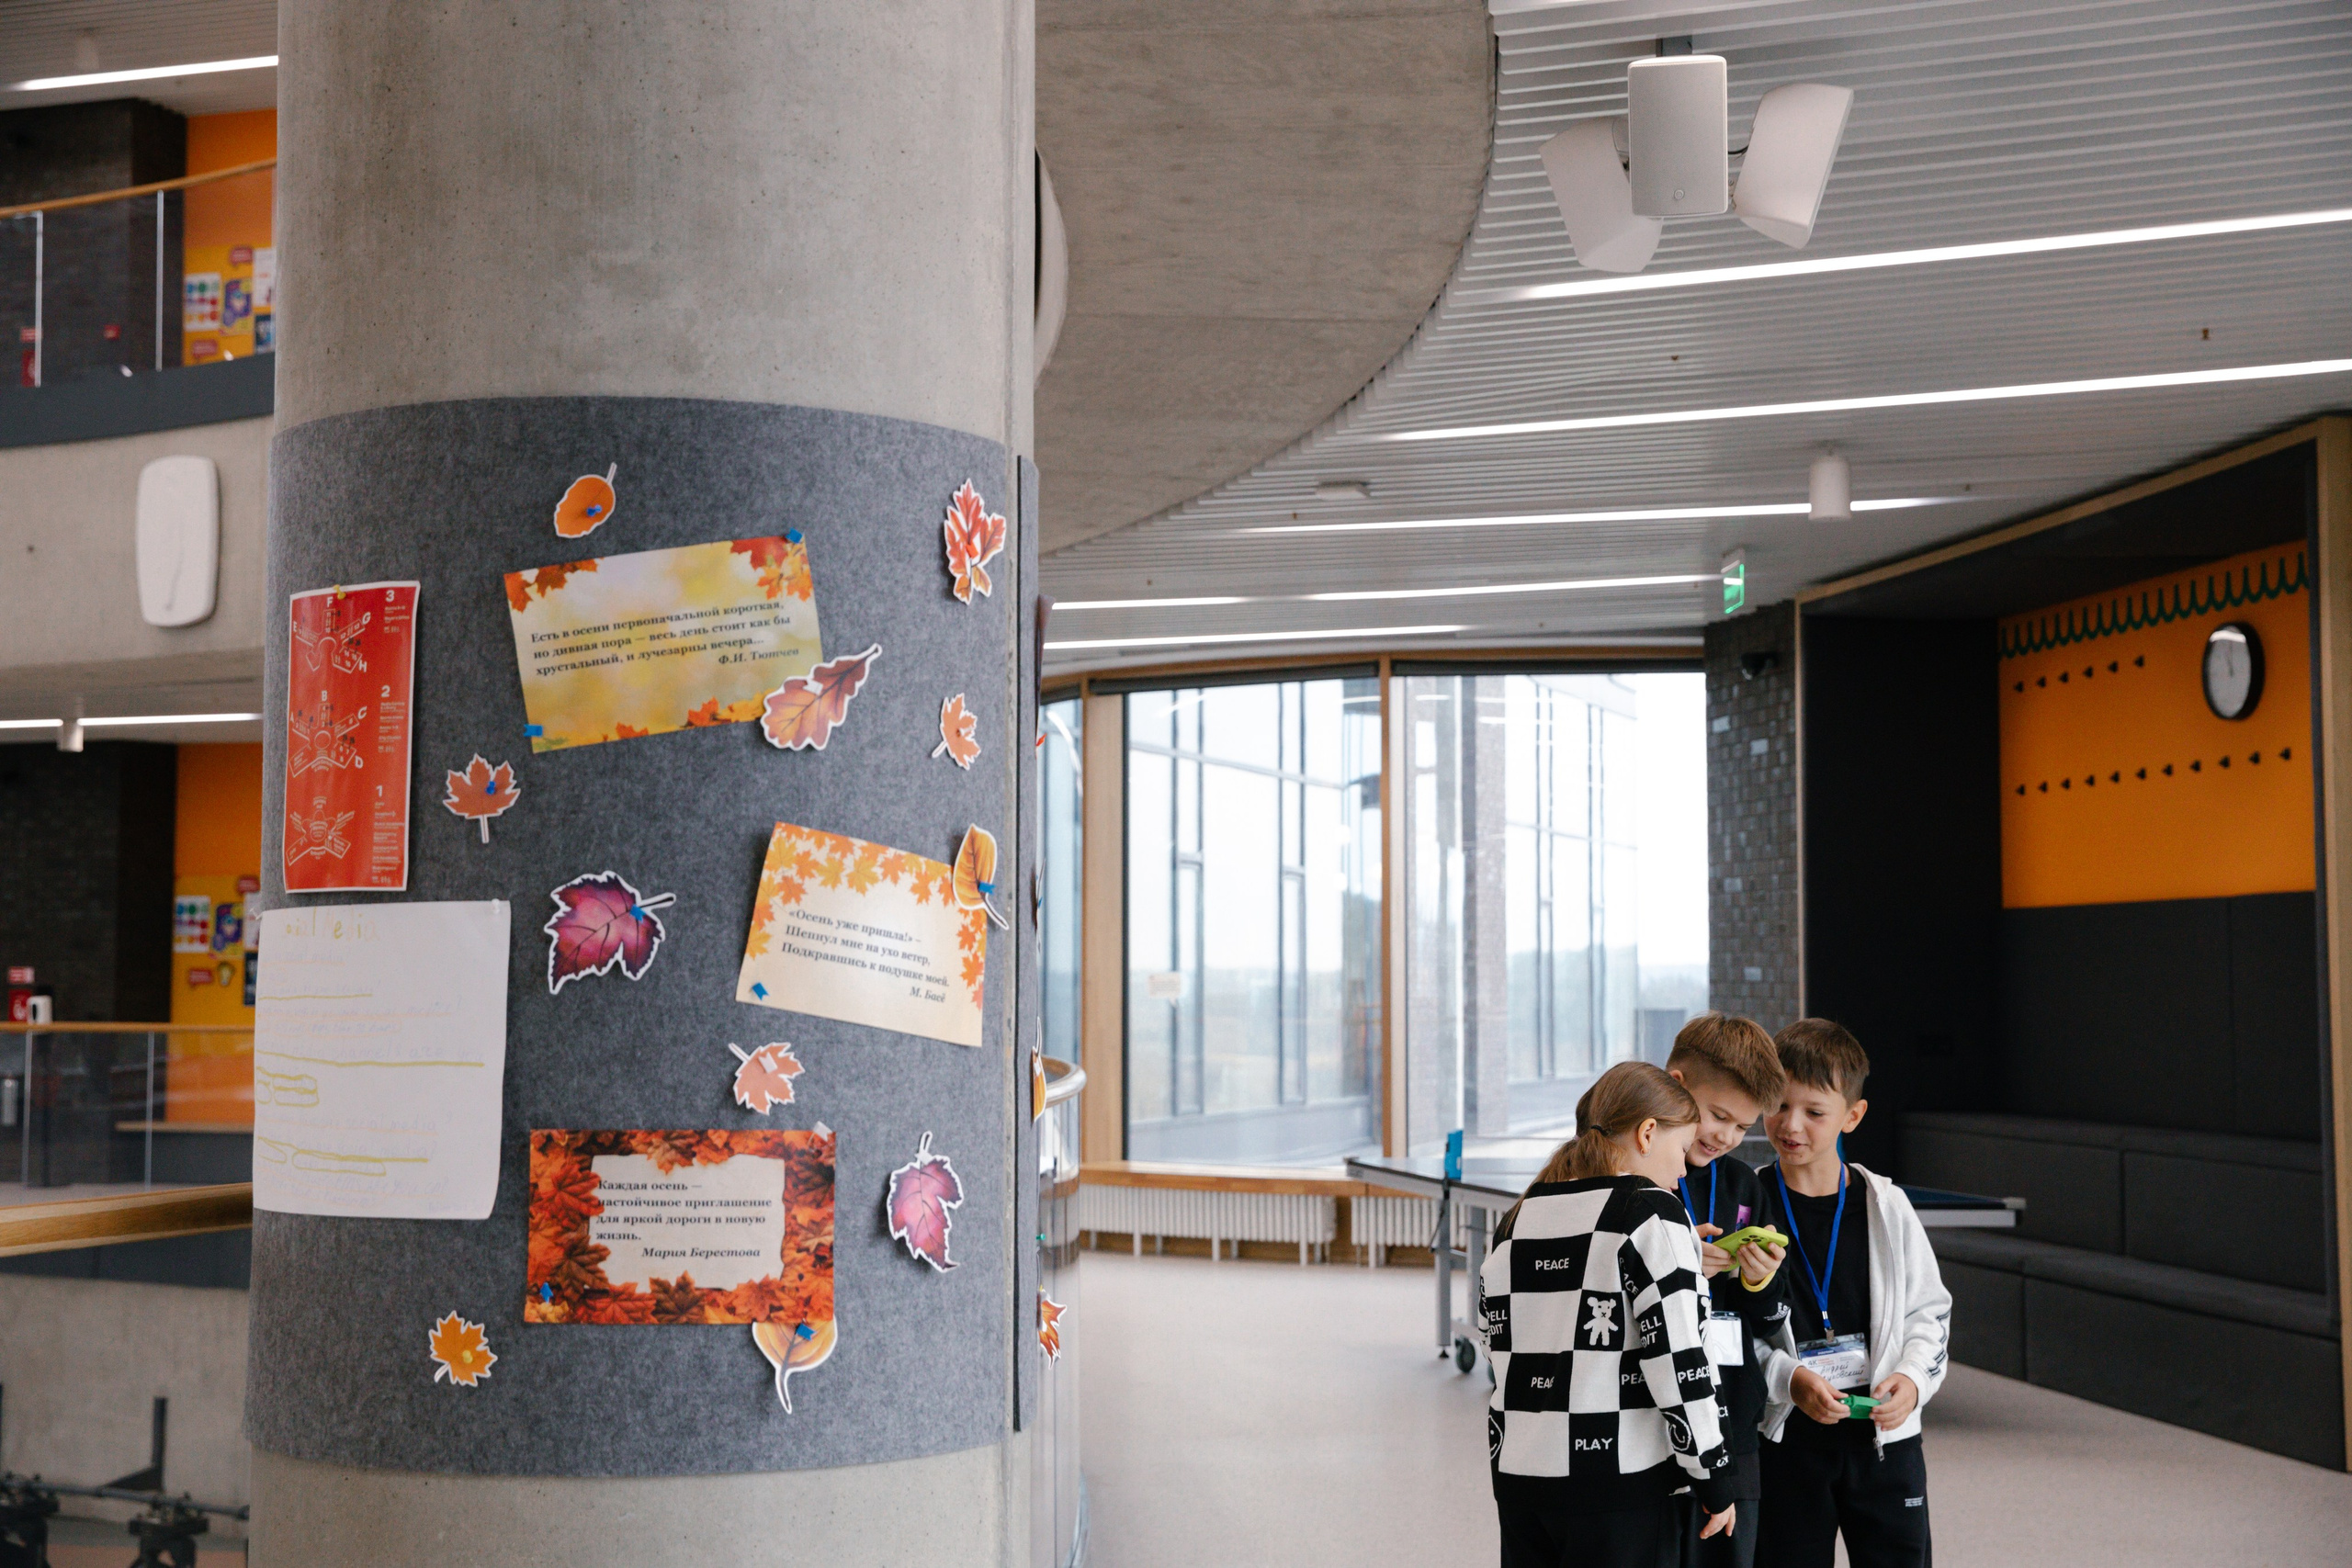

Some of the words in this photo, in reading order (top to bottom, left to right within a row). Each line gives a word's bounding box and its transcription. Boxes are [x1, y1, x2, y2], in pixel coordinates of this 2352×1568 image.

[326, 596, 333, 607] F
[386, 590, 395, 602] 3
[362, 612, 371, 625] G
[531, 633, 560, 643] Есть
[572, 625, 609, 636] осени
[613, 606, 719, 630] первоначальной
[723, 602, 785, 615] короткая,
[552, 643, 598, 657] дивная
[602, 637, 631, 649] пора
[649, 630, 676, 641] весь
[679, 626, 708, 638] день
[712, 622, 745, 633] стоит
[750, 618, 771, 628] как
[774, 615, 790, 625] бы
[536, 654, 623, 676] хрустальный,
[638, 643, 707, 660] лучезарны
[718, 653, 747, 665] Ф.И.
[751, 649, 799, 660] Тютчев
[358, 660, 368, 672] H
[322, 690, 327, 701] B
[380, 685, 390, 697] 2
[357, 705, 368, 719] C
[355, 755, 363, 769] D
[376, 784, 383, 797] 1
[789, 908, 833, 926] «Осень
[835, 919, 859, 931] уже
[861, 924, 912, 942] пришла!»
[786, 924, 838, 944] Шепнул
[841, 938, 864, 949] мне
[865, 944, 879, 953] на
[880, 946, 899, 957] ухо
[901, 951, 931, 966] ветер,
[782, 942, 867, 968] Подкравшись
[869, 962, 876, 970] к
[878, 964, 923, 980] подушке
[925, 974, 950, 987] моей.
[910, 986, 922, 998] М.
[924, 989, 946, 1003] Басё
[598, 1180, 648, 1191] Каждая
[651, 1182, 688, 1190] осень
[597, 1197, 682, 1207] настойчивое
[684, 1200, 772, 1210] приглашение
[596, 1215, 619, 1224] для
[623, 1213, 662, 1226] яркой
[665, 1216, 711, 1226] дороги
[725, 1216, 765, 1226] новую
[641, 1247, 686, 1259] Мария
[690, 1247, 761, 1259] Берестова
[1534, 1258, 1570, 1271] PEACE
[1677, 1365, 1710, 1384] PEACE
[1574, 1438, 1613, 1451] PLAY
